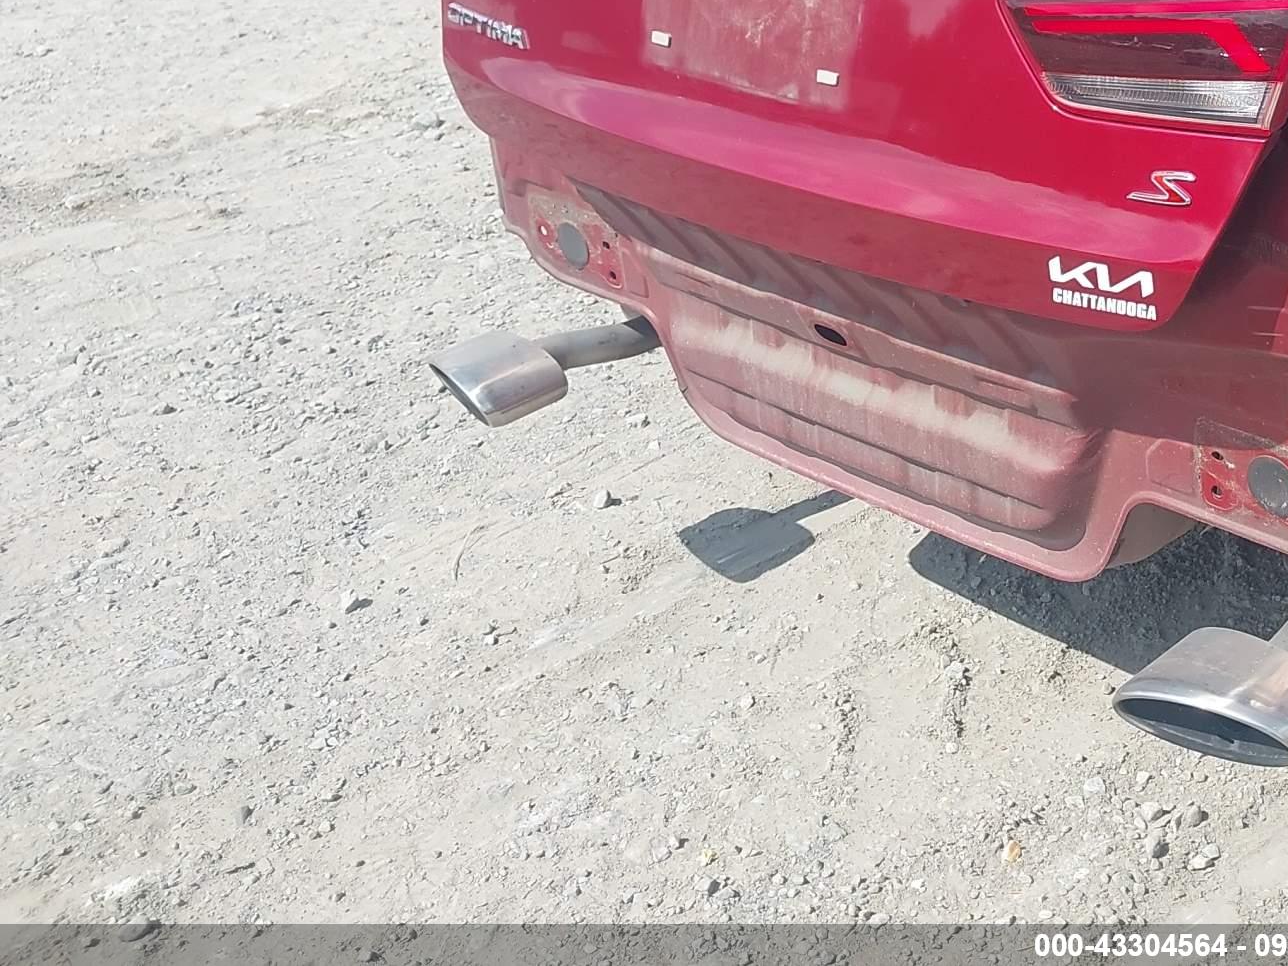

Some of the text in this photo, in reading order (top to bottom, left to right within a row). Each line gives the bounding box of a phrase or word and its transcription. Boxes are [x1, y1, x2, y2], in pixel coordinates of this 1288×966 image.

[447, 1, 531, 51] OPTIMA
[1126, 169, 1197, 207] S
[1052, 286, 1158, 322] CHATTANOOGA
